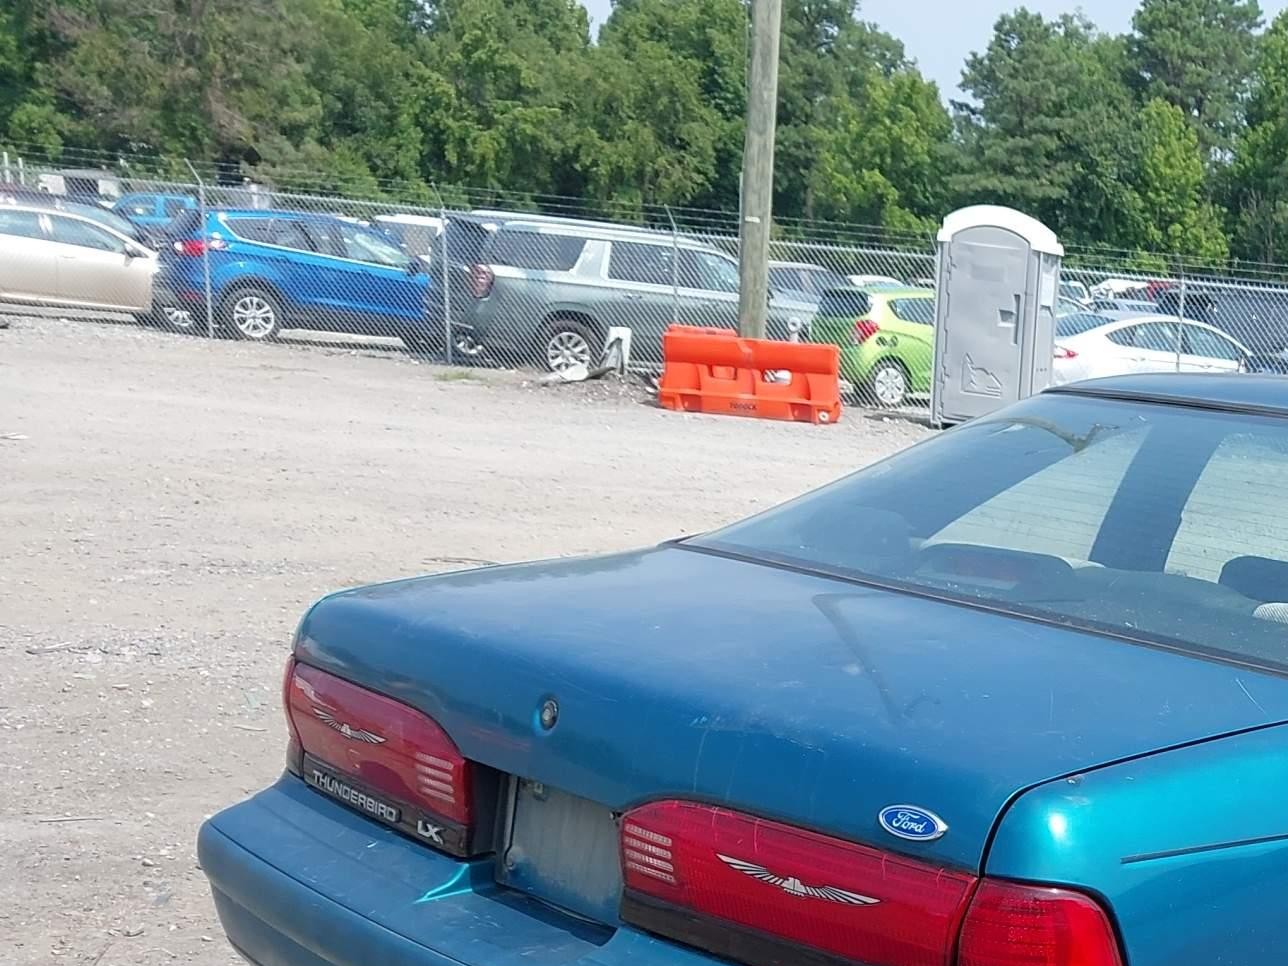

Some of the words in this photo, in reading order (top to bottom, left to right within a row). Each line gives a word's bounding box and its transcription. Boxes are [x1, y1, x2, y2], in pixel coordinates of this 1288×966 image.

[313, 770, 397, 822] THUNDERBIRD
[418, 820, 444, 845] LX
[892, 811, 926, 833] Ford
